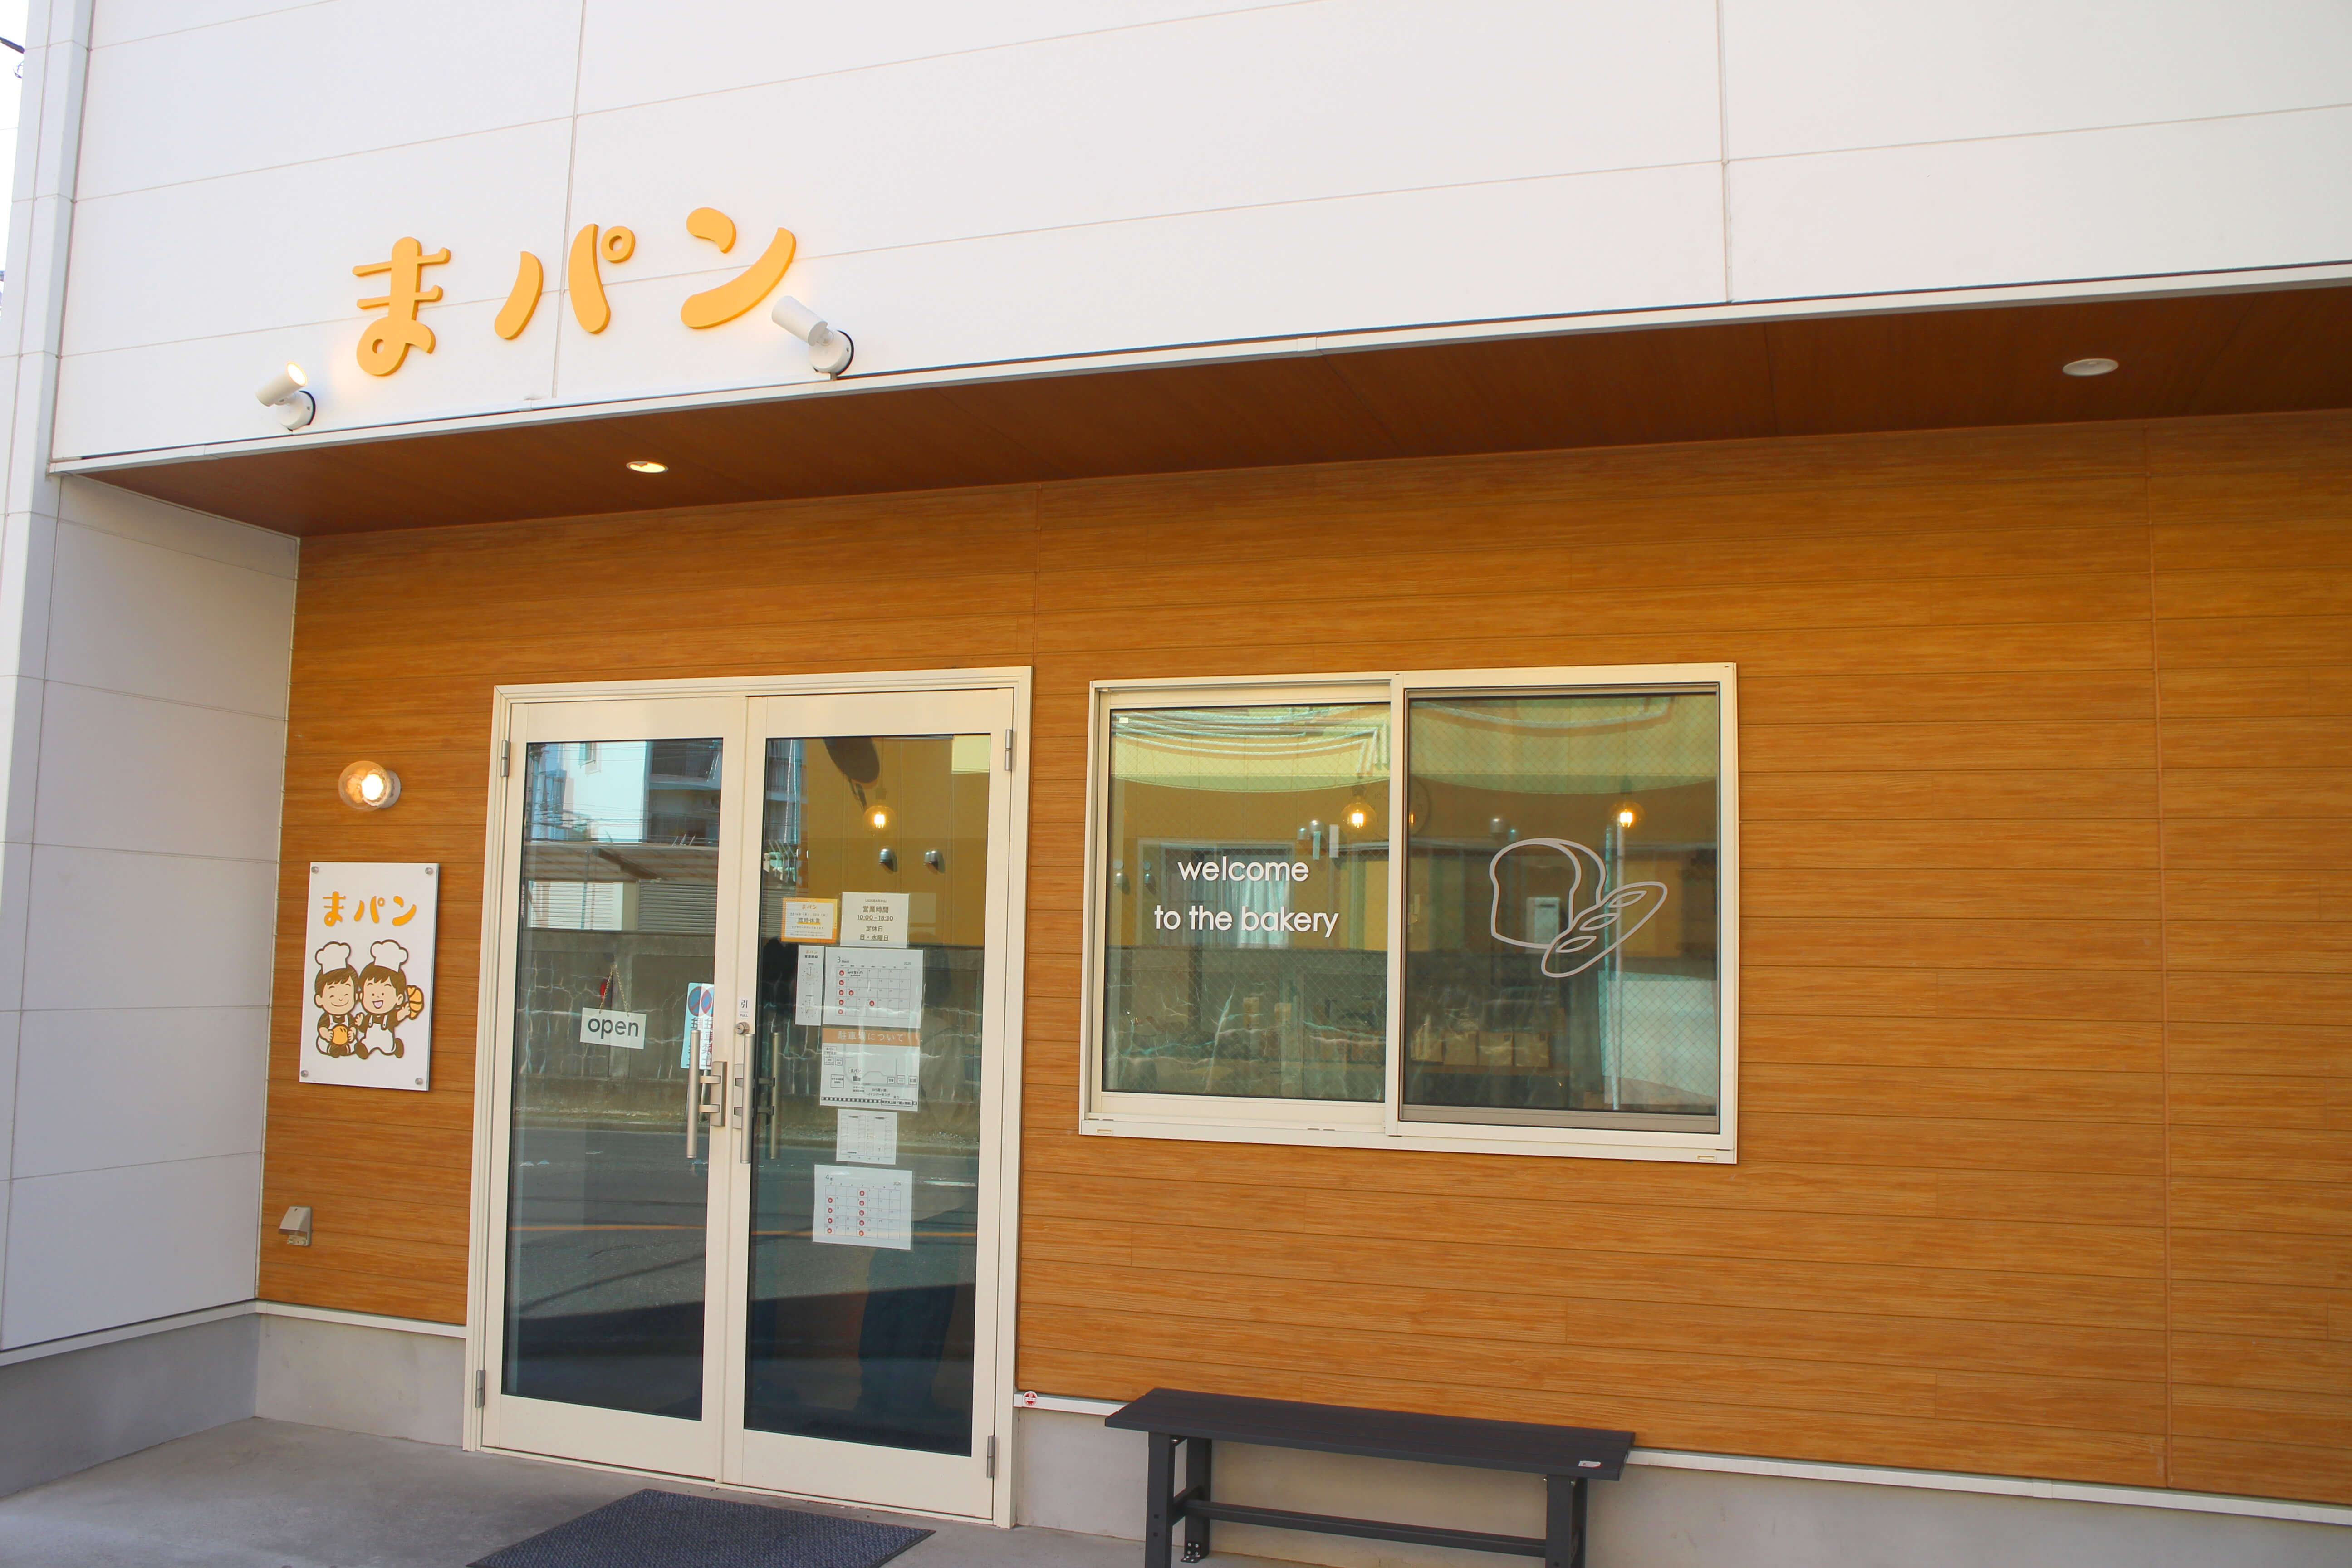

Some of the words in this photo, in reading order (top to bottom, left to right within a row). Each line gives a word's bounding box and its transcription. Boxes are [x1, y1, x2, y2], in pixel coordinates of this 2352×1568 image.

[353, 207, 796, 376] まパン
[1177, 856, 1309, 882] welcome
[323, 891, 416, 926] まパン
[1154, 905, 1181, 930] to
[1189, 905, 1233, 931] the
[1241, 906, 1339, 938] bakery
[740, 1000, 748, 1009] 引
[588, 1018, 639, 1039] open
